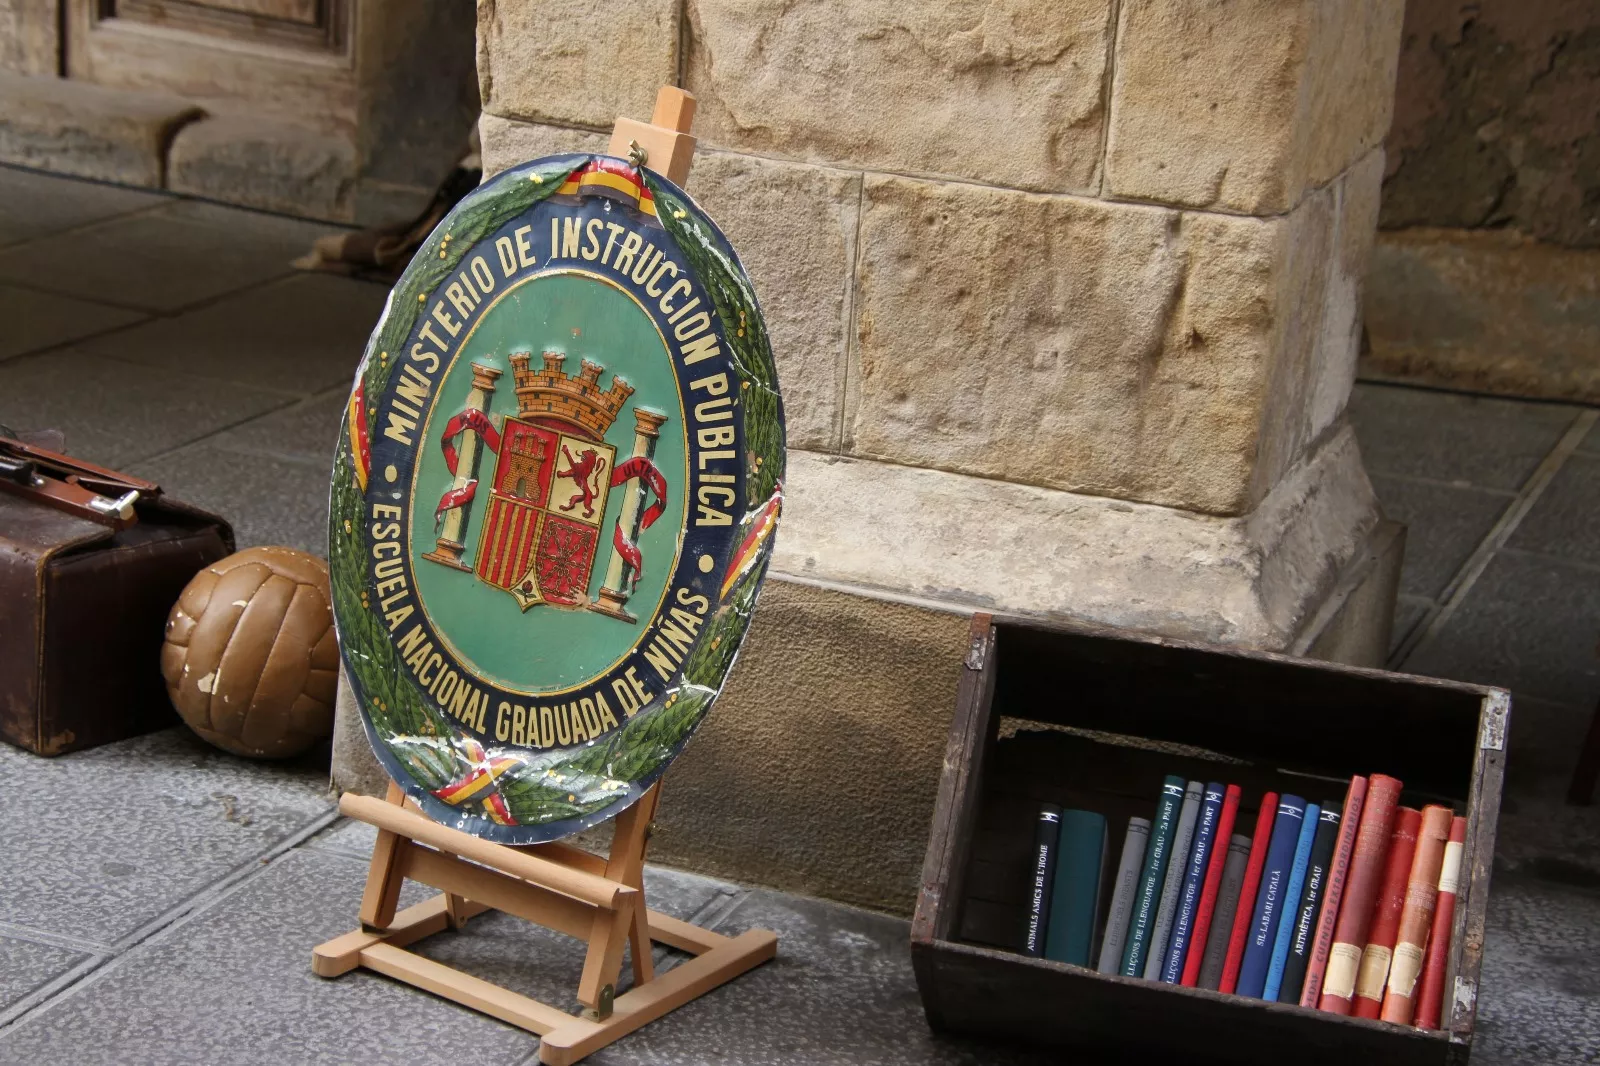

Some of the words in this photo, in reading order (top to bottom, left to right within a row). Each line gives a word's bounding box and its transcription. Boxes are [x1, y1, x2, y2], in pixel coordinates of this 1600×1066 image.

[383, 255, 496, 446] MINISTERIO
[495, 224, 536, 279] DE
[371, 503, 415, 632] ESCUELA
[396, 623, 490, 735] NACIONAL
[494, 690, 619, 748] GRADUADA
[611, 666, 654, 719] DE
[643, 587, 709, 682] NIÑAS
[1162, 801, 1173, 821] PART
[1203, 806, 1215, 826] PART
[1036, 844, 1048, 875] L'HOME
[1153, 835, 1166, 859] GRAU
[1194, 841, 1207, 865] GRAU
[1151, 859, 1160, 870] 1er
[1191, 864, 1201, 877] 1er
[1035, 875, 1044, 887] DE
[1309, 865, 1323, 890] GRAU
[1315, 909, 1335, 964] CUENTOS
[1328, 795, 1362, 906] EXTRAORDINARIOS
[1031, 888, 1042, 913] AMICS
[1137, 876, 1156, 927] LLENGUATGE
[1306, 889, 1317, 902] 1er
[1177, 883, 1197, 936] LLENGUATGE
[1026, 914, 1038, 951] ANIMALS
[1134, 928, 1145, 941] DE
[1174, 936, 1184, 948] DE
[1126, 941, 1142, 976] LLIÇONS
[1165, 949, 1181, 985] LLIÇONS
